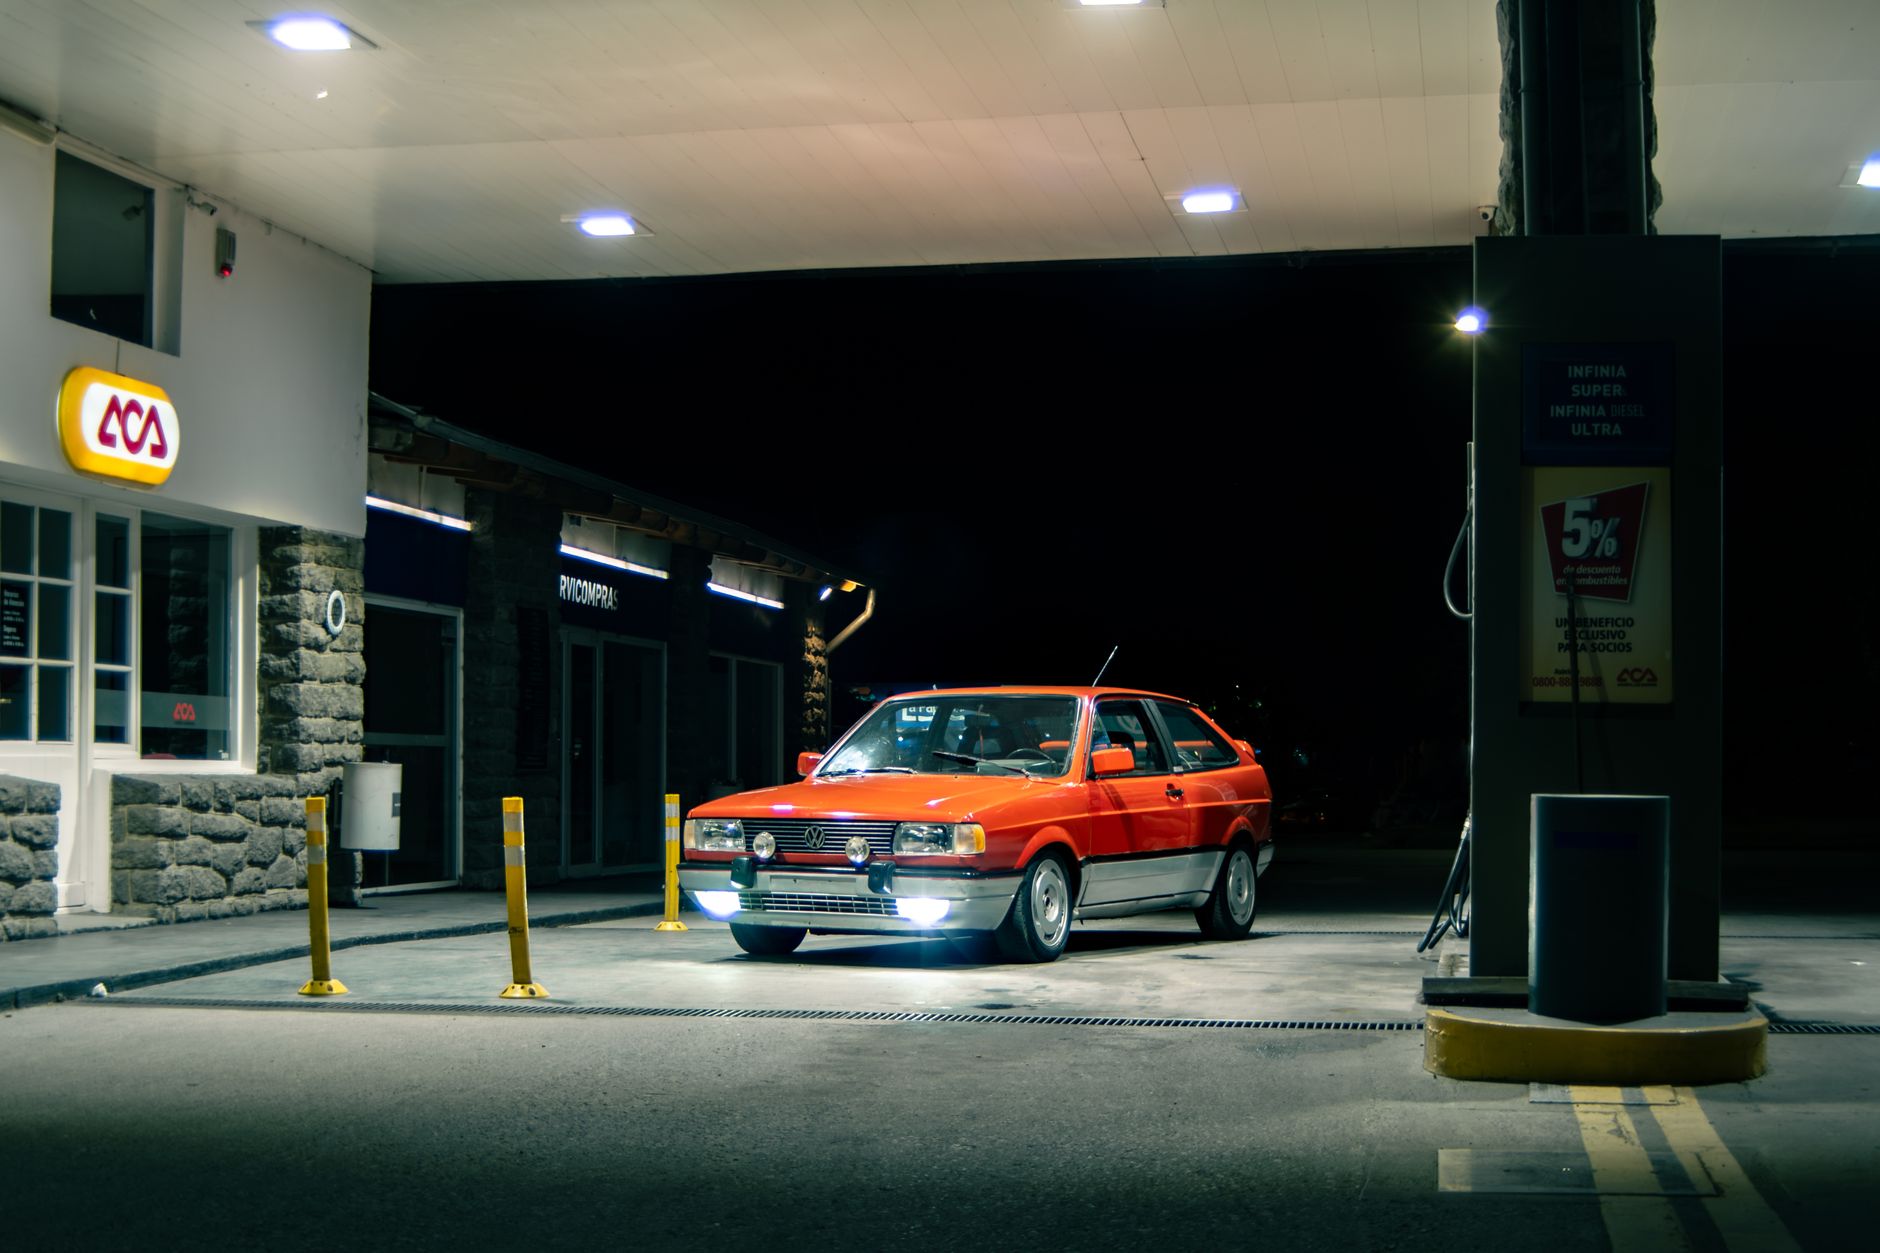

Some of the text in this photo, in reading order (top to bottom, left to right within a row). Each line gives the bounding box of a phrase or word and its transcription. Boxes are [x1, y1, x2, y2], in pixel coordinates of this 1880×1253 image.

[1567, 365, 1627, 378] INFINIA
[1571, 384, 1623, 397] SUPER
[1549, 404, 1646, 417] INFINIA DIESEL
[98, 394, 168, 459] ACA
[1571, 423, 1622, 436] ULTRA
[1561, 497, 1622, 559] 5%
[1576, 565, 1621, 574] descuento
[1575, 618, 1634, 628] BENEFICIO
[1564, 630, 1626, 640] ECLUSIVO
[1591, 642, 1633, 652] SOCIOS
[1617, 667, 1658, 682] ACA
[172, 703, 197, 721] ACA
